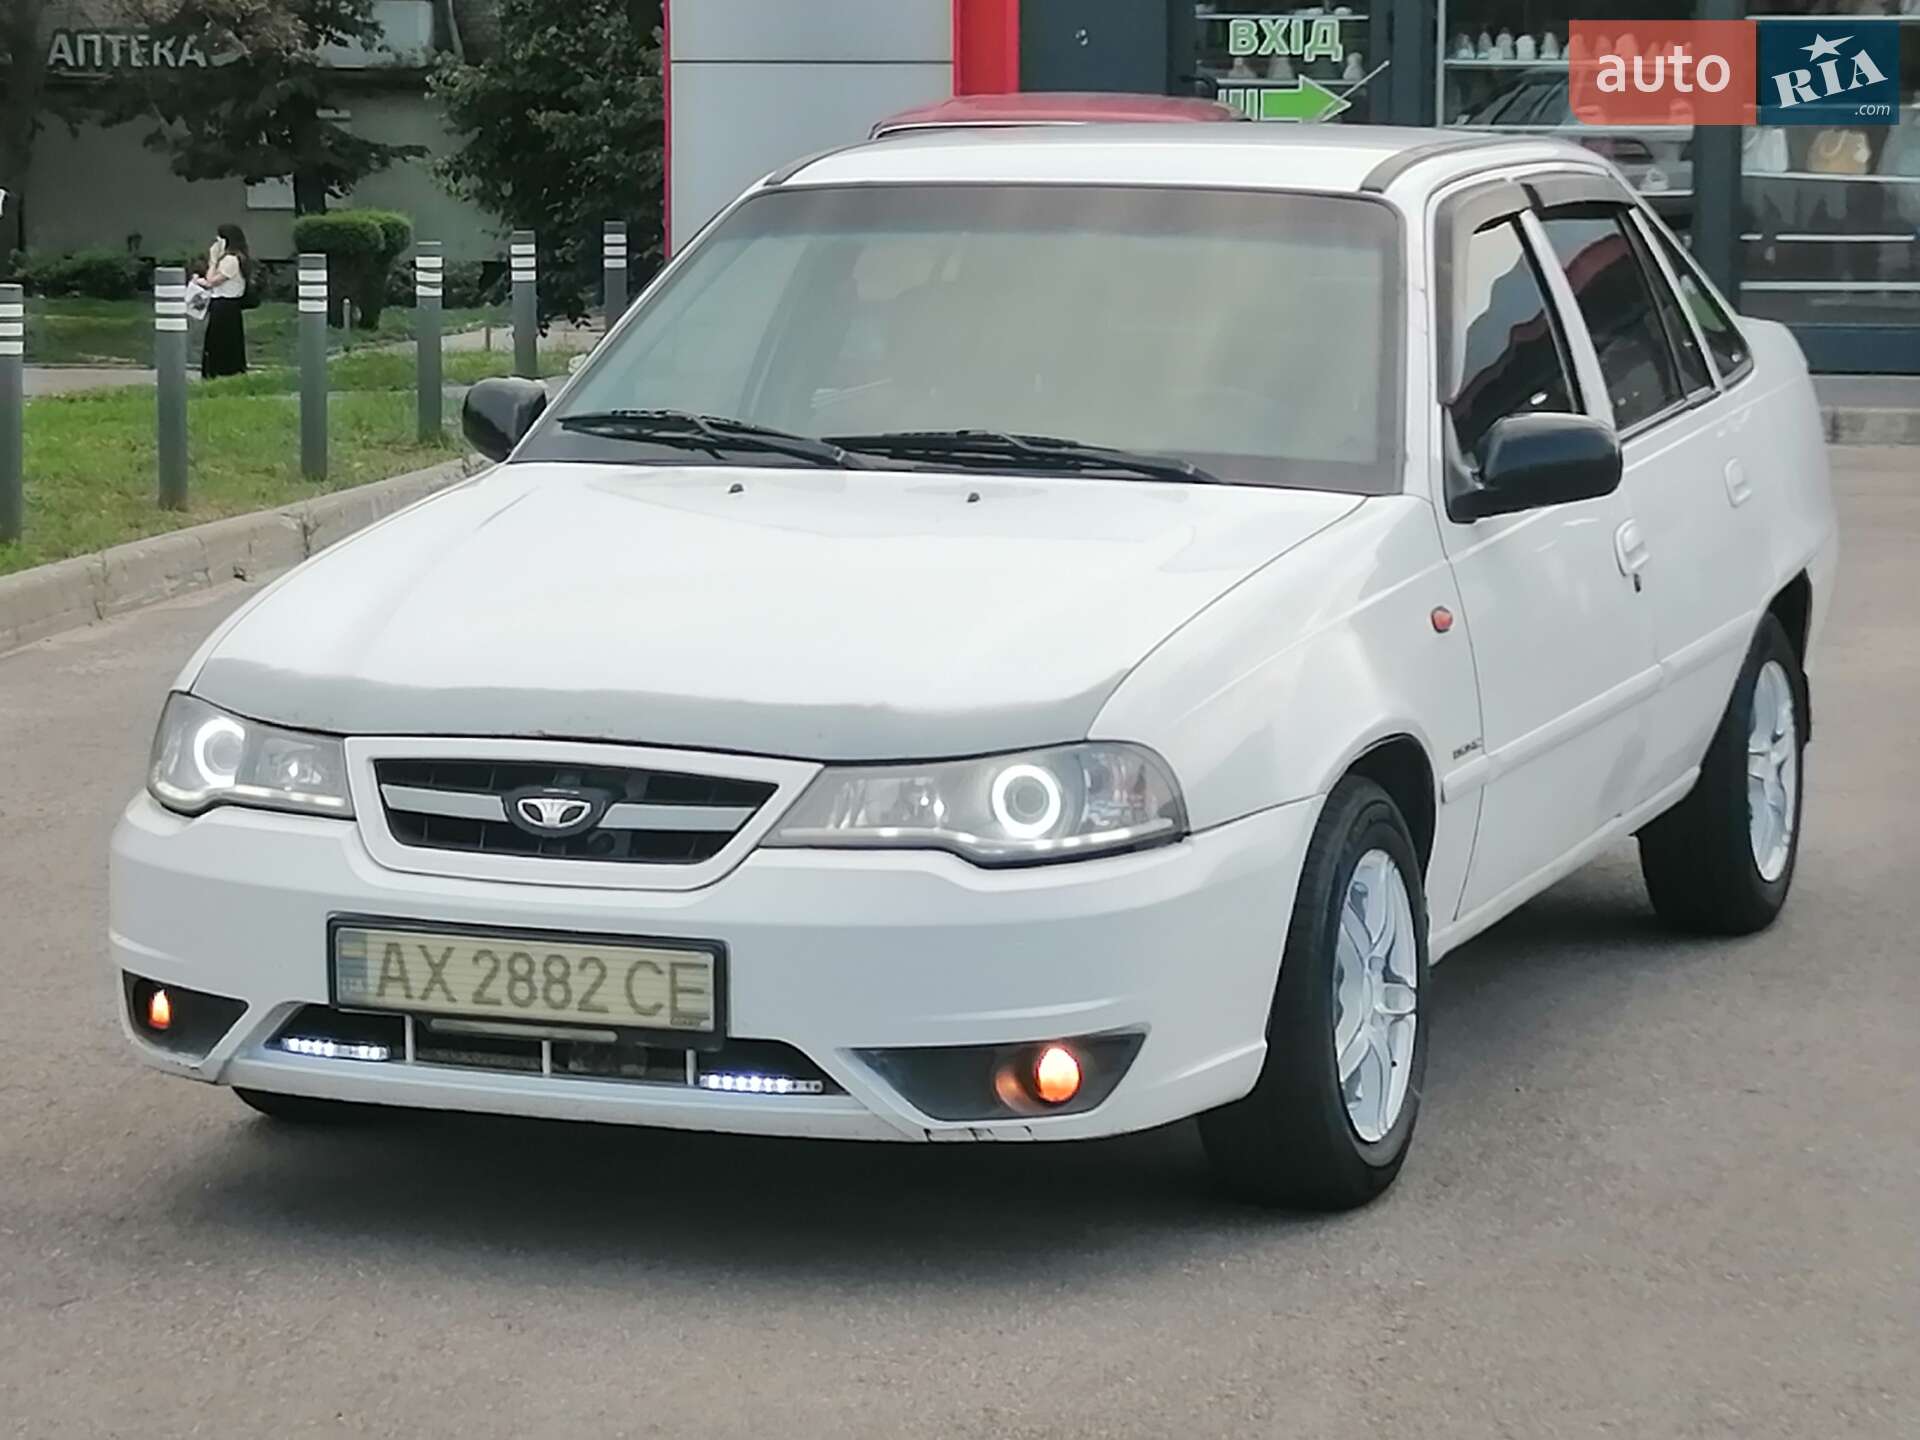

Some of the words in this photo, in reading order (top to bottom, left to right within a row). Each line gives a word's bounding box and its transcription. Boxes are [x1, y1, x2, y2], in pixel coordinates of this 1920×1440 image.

[48, 33, 208, 68] АПТЕКА
[1229, 18, 1344, 62] ВХІД
[376, 942, 457, 1002] AX
[472, 949, 609, 1013] 2882
[625, 960, 711, 1021] CE
